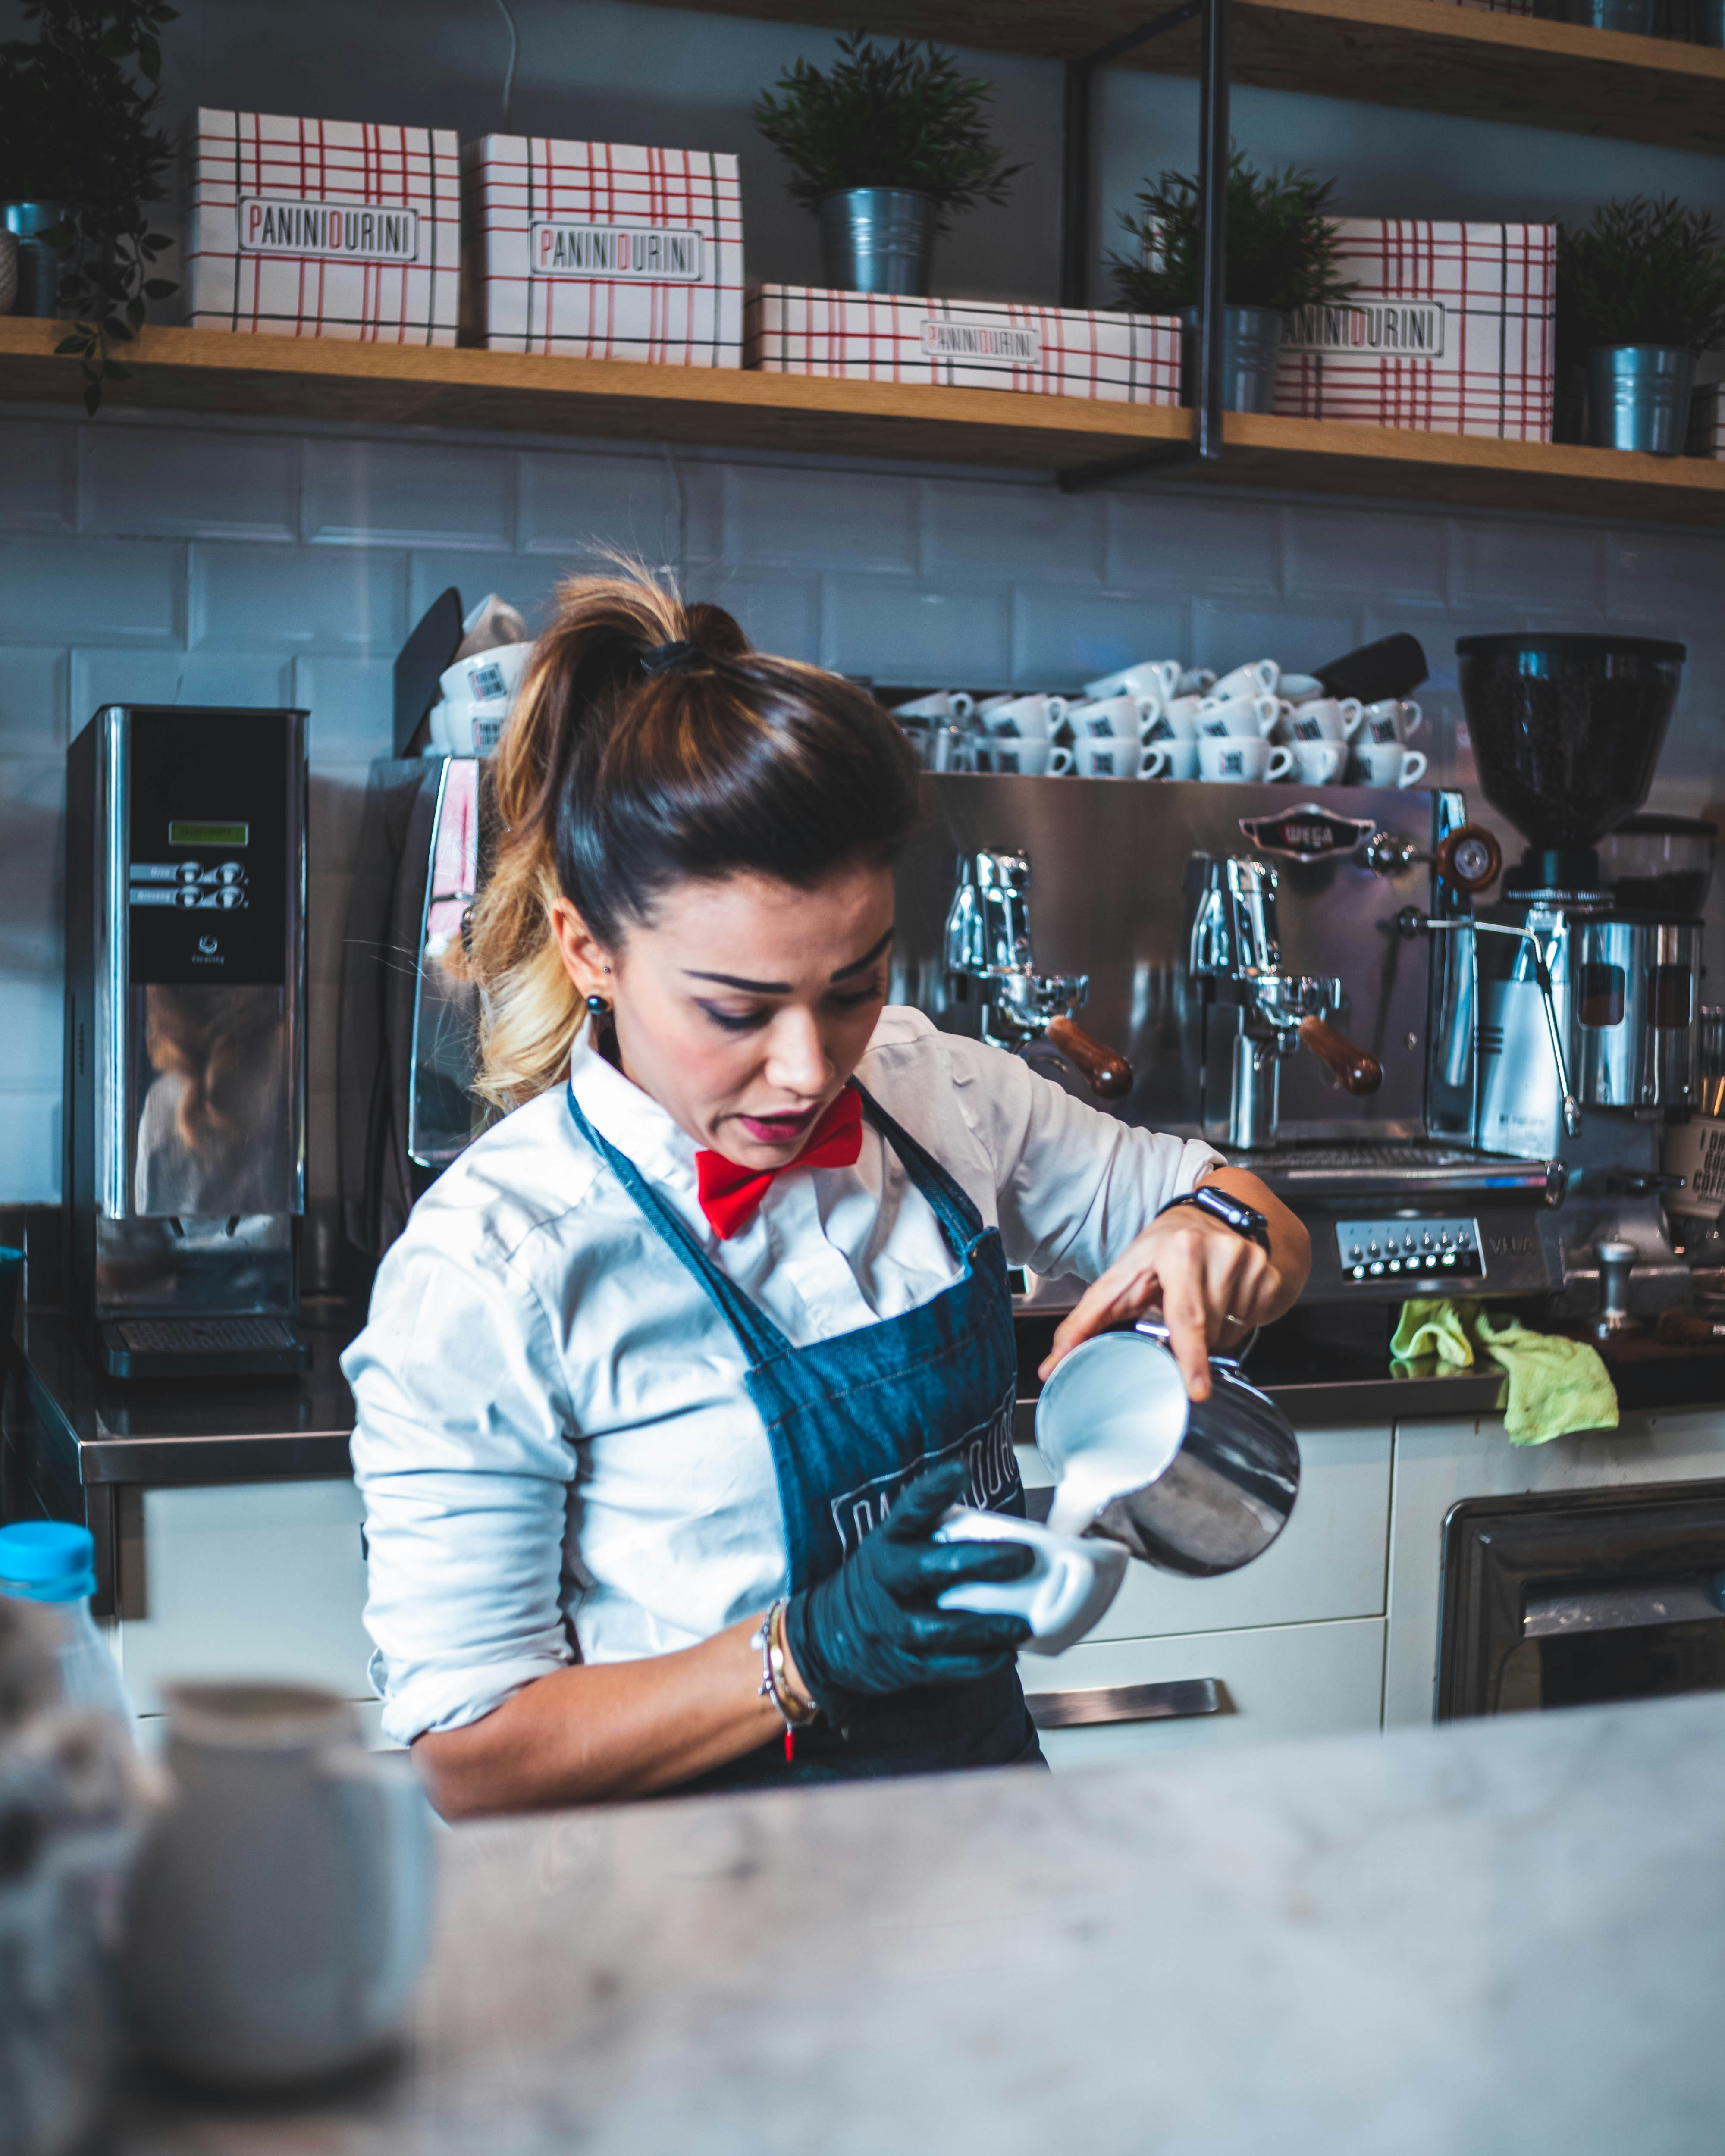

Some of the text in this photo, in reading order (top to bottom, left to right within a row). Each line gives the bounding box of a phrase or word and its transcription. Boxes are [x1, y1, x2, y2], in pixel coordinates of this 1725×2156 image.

[249, 204, 409, 254] PANINIDURINI
[541, 229, 695, 273] PANINIDURINI
[1280, 304, 1434, 350] ANINIDURINI
